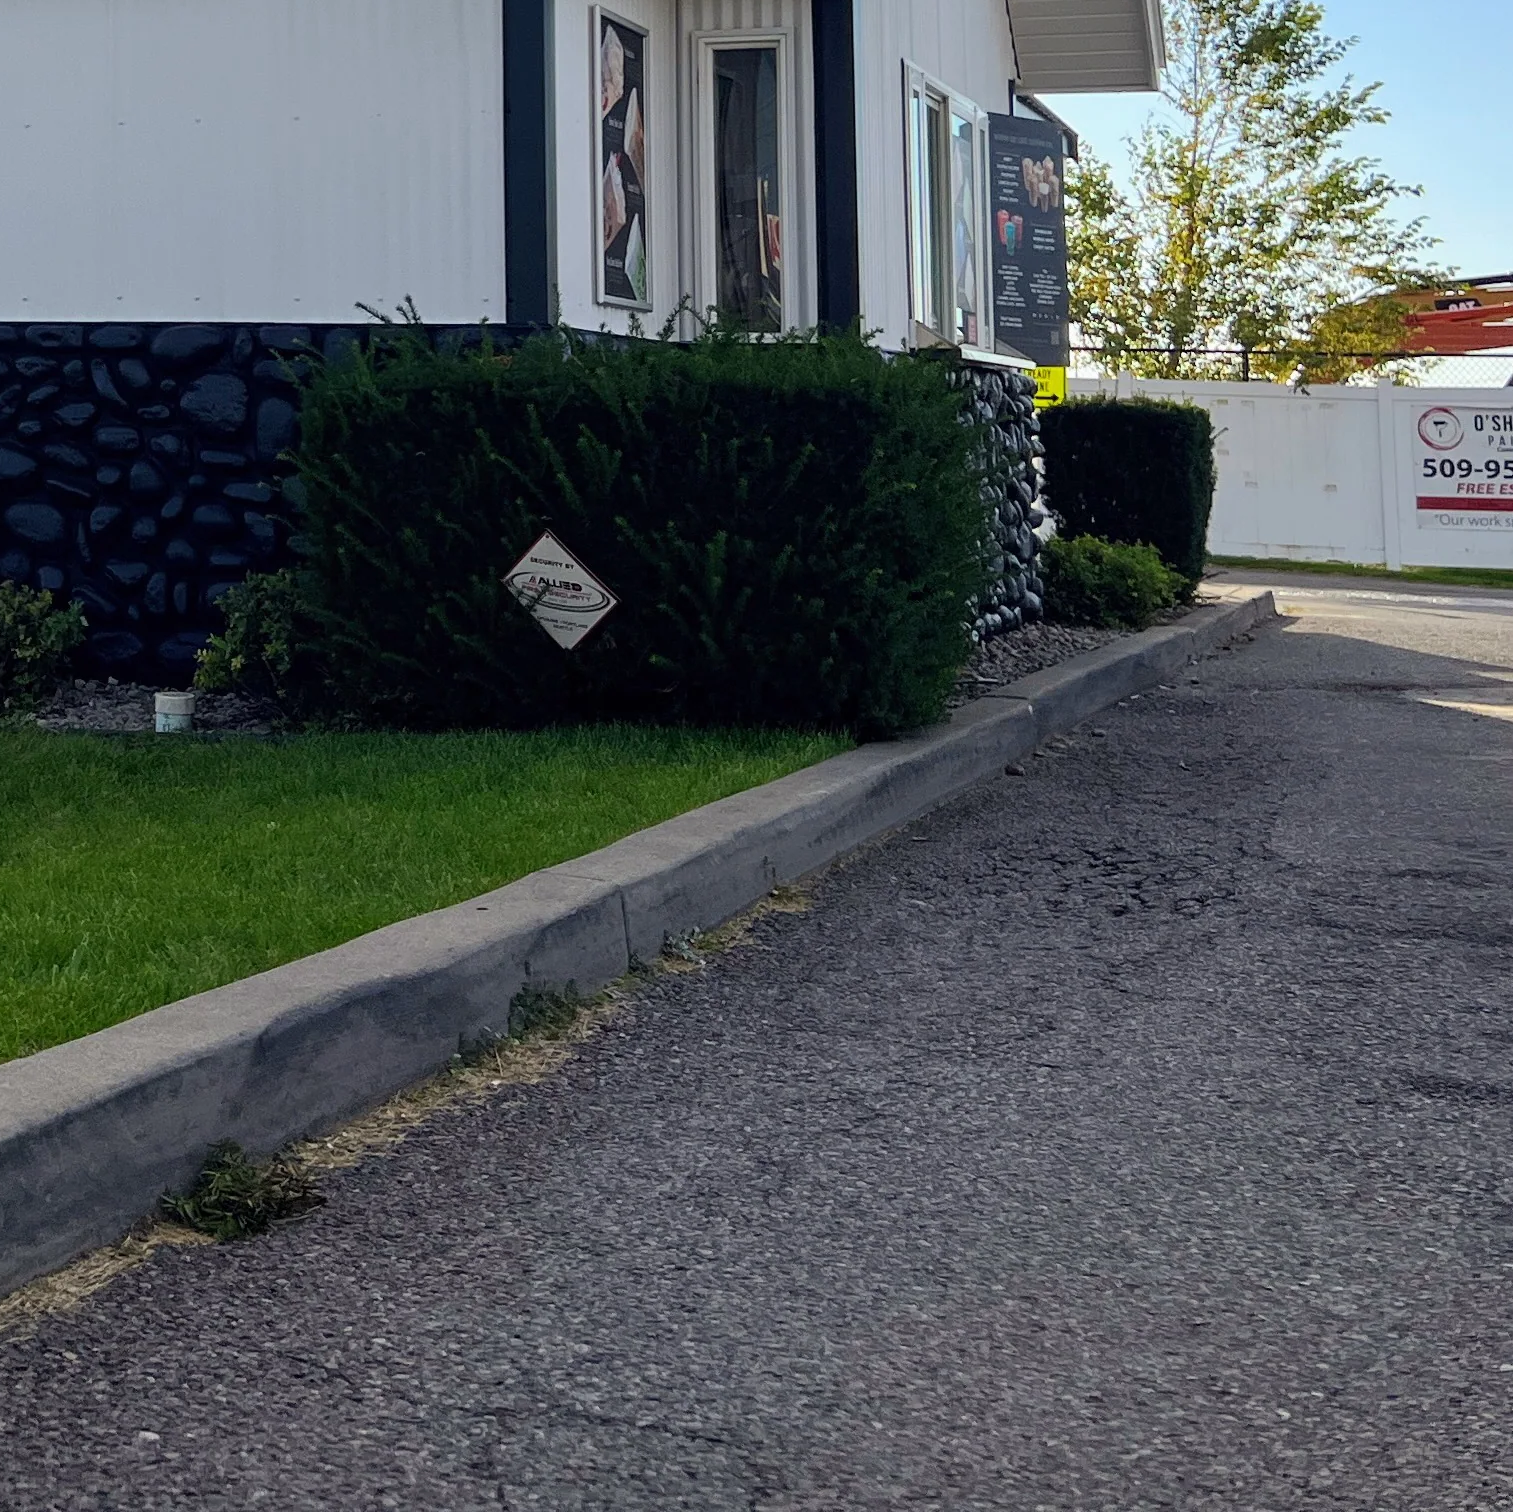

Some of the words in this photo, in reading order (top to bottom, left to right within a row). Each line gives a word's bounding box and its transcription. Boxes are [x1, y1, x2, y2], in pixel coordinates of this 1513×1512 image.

[1474, 414, 1513, 432] O'SH
[1423, 458, 1513, 479] 509-95
[1456, 483, 1495, 495] FREE
[1468, 514, 1502, 527] work
